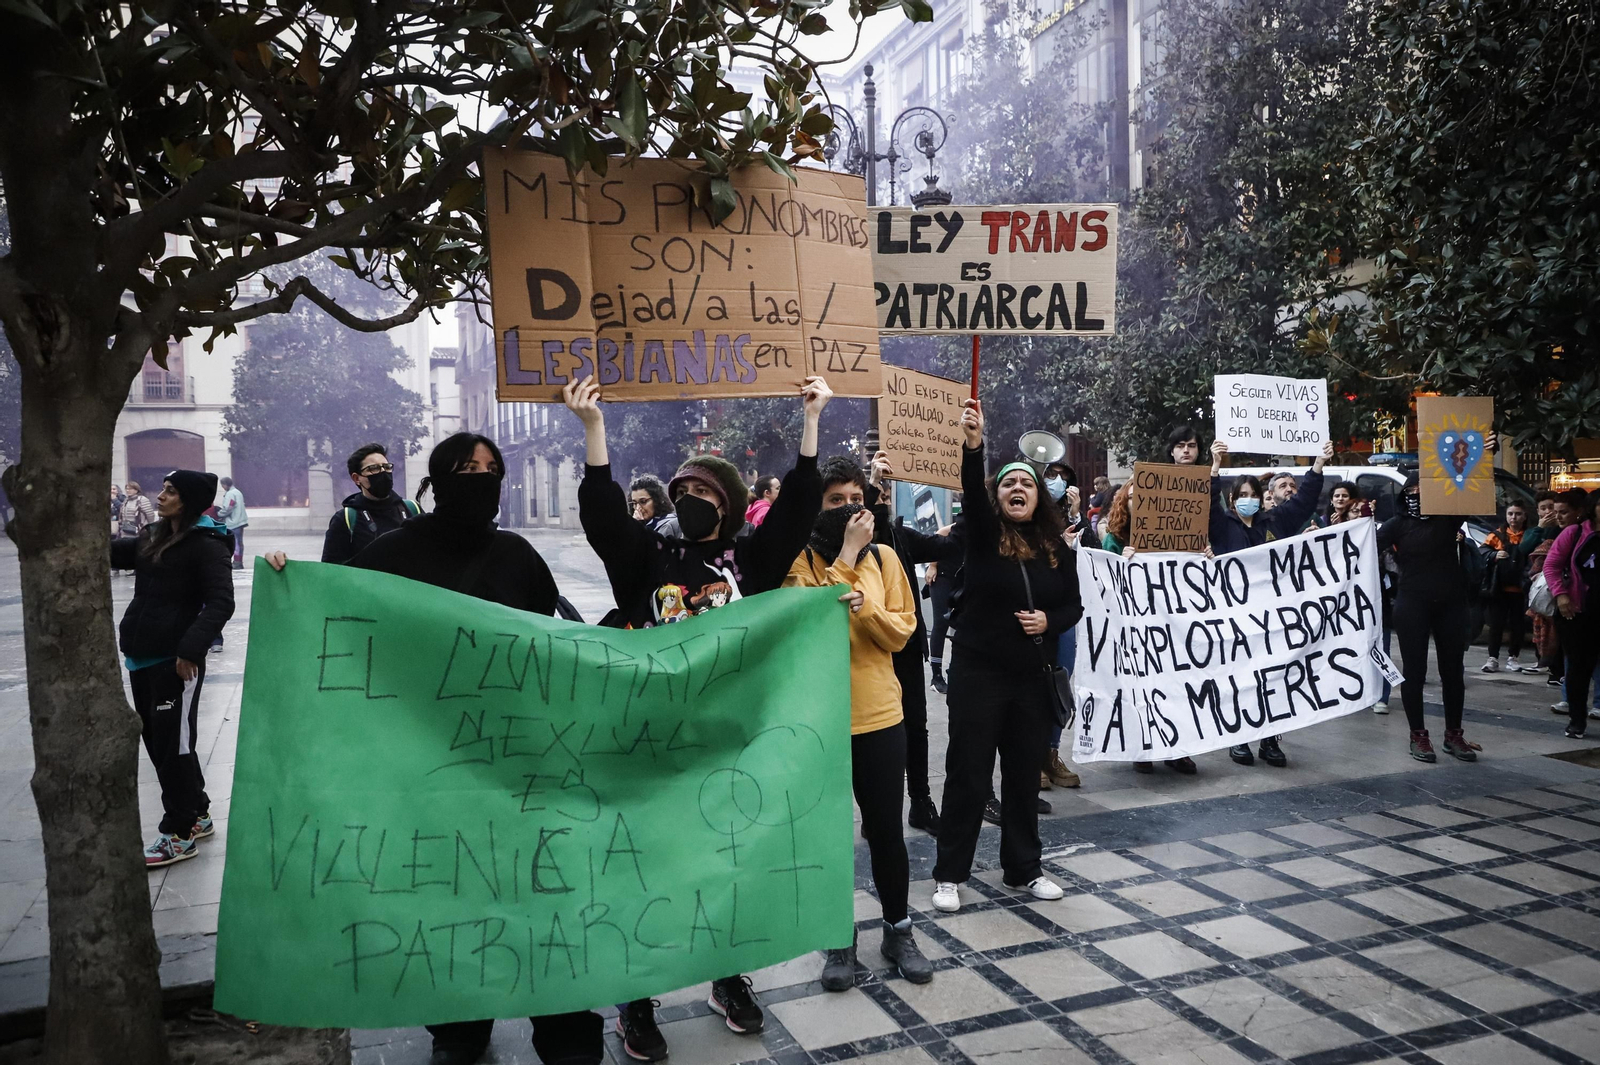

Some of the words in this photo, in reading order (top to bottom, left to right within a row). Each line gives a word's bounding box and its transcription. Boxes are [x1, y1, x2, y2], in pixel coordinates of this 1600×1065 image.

[503, 168, 626, 226] MIS
[877, 210, 964, 254] LEY
[981, 210, 1110, 254] TRANS
[630, 234, 754, 274] SON:
[960, 261, 992, 281] ES
[874, 281, 1105, 331] PATRIARCAL
[753, 341, 792, 369] en
[810, 335, 869, 374] PAZ
[887, 372, 908, 396] NO
[914, 384, 953, 405] EXISTE
[1229, 383, 1272, 399] SEGUIR
[1276, 383, 1319, 401] VIVAS
[890, 400, 943, 424] IGUALDAD
[1230, 405, 1247, 418] NO
[1257, 406, 1297, 422] DEBERIA
[940, 449, 958, 458] UNA
[1227, 426, 1251, 438] SER
[1261, 428, 1273, 439] UN
[1278, 425, 1320, 443] LOGRO
[1136, 471, 1163, 490] CON
[1166, 475, 1184, 491] LAS
[1184, 478, 1210, 495] NIÑAS
[1136, 516, 1148, 530] DE
[1154, 513, 1192, 530] IRÁN
[1137, 494, 1145, 510] Y
[1147, 496, 1203, 515] MUJERES
[1132, 532, 1139, 545] Y
[1106, 557, 1249, 616] MACHISMO
[1269, 530, 1361, 597] MATA
[1248, 609, 1273, 655] Y
[1276, 583, 1377, 651] BORRA
[317, 616, 398, 700] EL
[437, 626, 749, 727] CONTRATO
[1101, 688, 1125, 753] A
[1131, 687, 1179, 751] LAS
[1184, 647, 1364, 740] MUJERES
[427, 709, 708, 775] SEXUAL
[511, 767, 600, 822] ES
[333, 882, 771, 998] PATRIARCAL
